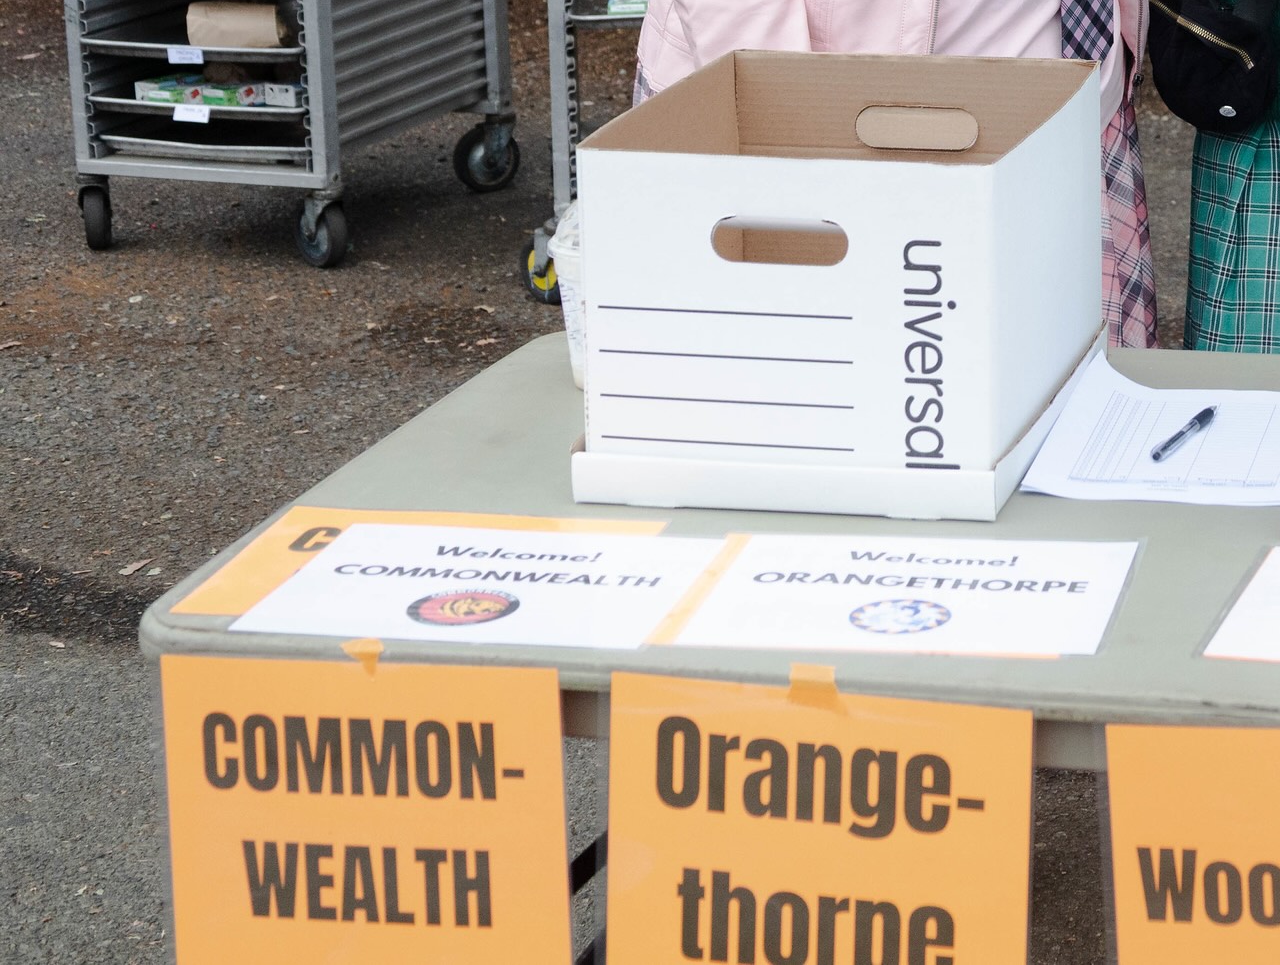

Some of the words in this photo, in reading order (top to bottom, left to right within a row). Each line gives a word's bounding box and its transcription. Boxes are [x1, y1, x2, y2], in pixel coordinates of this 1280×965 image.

[902, 239, 961, 471] universal
[333, 563, 662, 588] COMMONWEALTH
[436, 545, 604, 563] Welcome!
[752, 571, 1089, 594] ORANGETHORPE
[850, 550, 1019, 567] Welcome!
[202, 711, 525, 801] COMMON-
[656, 715, 985, 839] Orange-
[242, 840, 493, 928] WEALTH
[676, 867, 956, 965] thorpe
